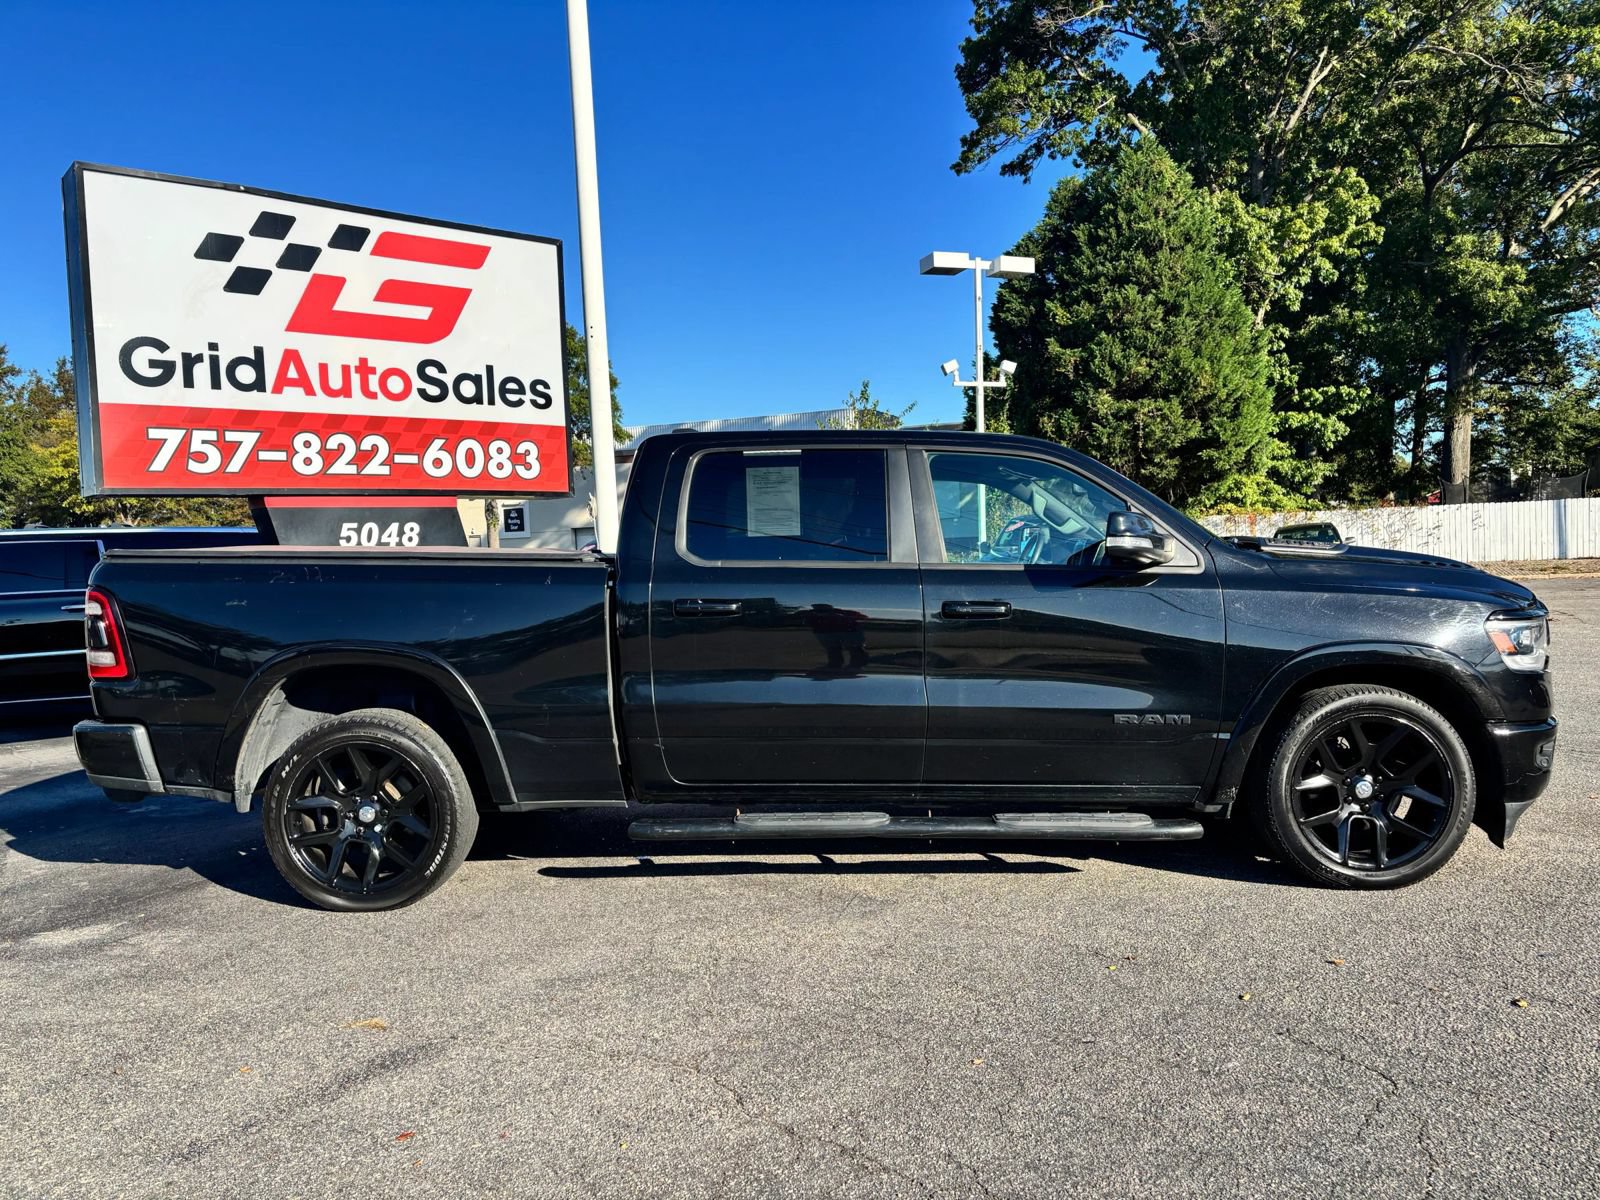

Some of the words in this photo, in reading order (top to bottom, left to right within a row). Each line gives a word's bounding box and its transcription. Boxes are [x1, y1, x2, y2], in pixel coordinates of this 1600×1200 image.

[146, 426, 541, 480] 757-822-6083
[339, 522, 420, 547] 5048
[1113, 714, 1191, 725] RAM
